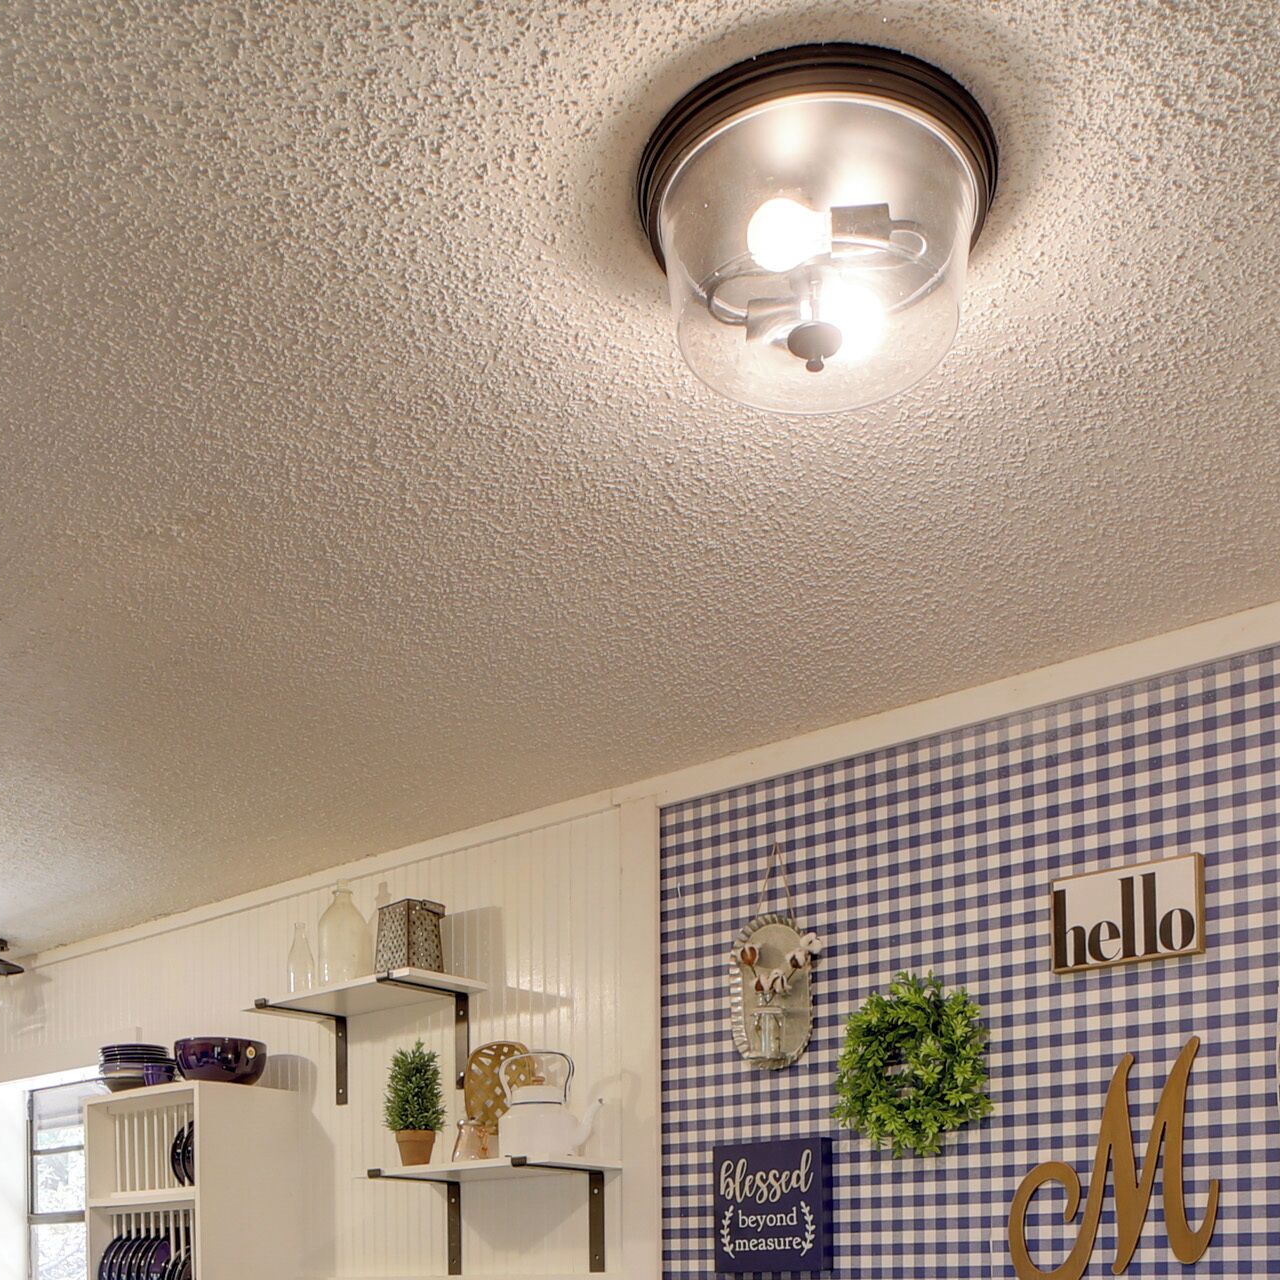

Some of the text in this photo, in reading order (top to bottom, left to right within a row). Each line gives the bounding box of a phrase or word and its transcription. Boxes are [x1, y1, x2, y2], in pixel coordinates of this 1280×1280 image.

[1053, 872, 1195, 968] hello
[720, 1149, 813, 1204] blessed
[738, 1206, 797, 1232] beyond
[735, 1236, 801, 1251] measure
